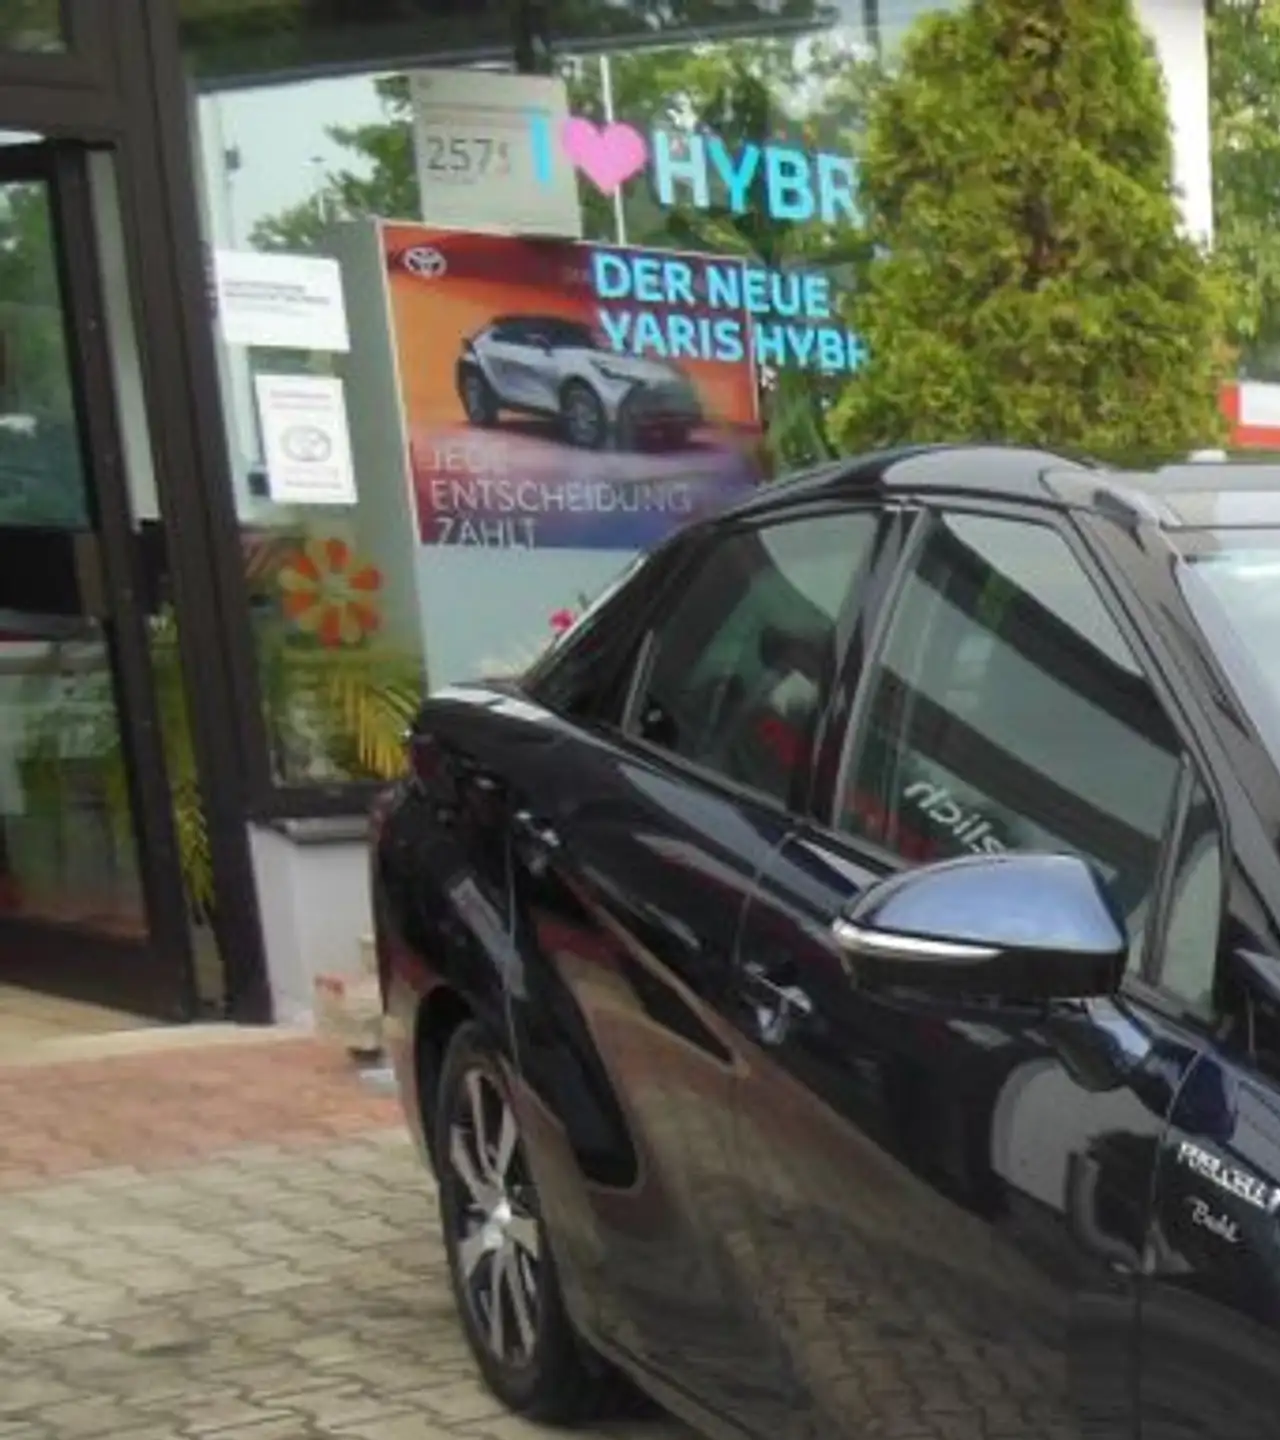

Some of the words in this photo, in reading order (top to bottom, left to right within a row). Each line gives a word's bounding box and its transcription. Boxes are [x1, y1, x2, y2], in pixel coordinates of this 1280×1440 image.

[594, 252, 695, 306] DER
[706, 264, 830, 319] NEUE
[599, 308, 744, 364] YARIS
[430, 477, 694, 513] ENTSCHEIDUNG
